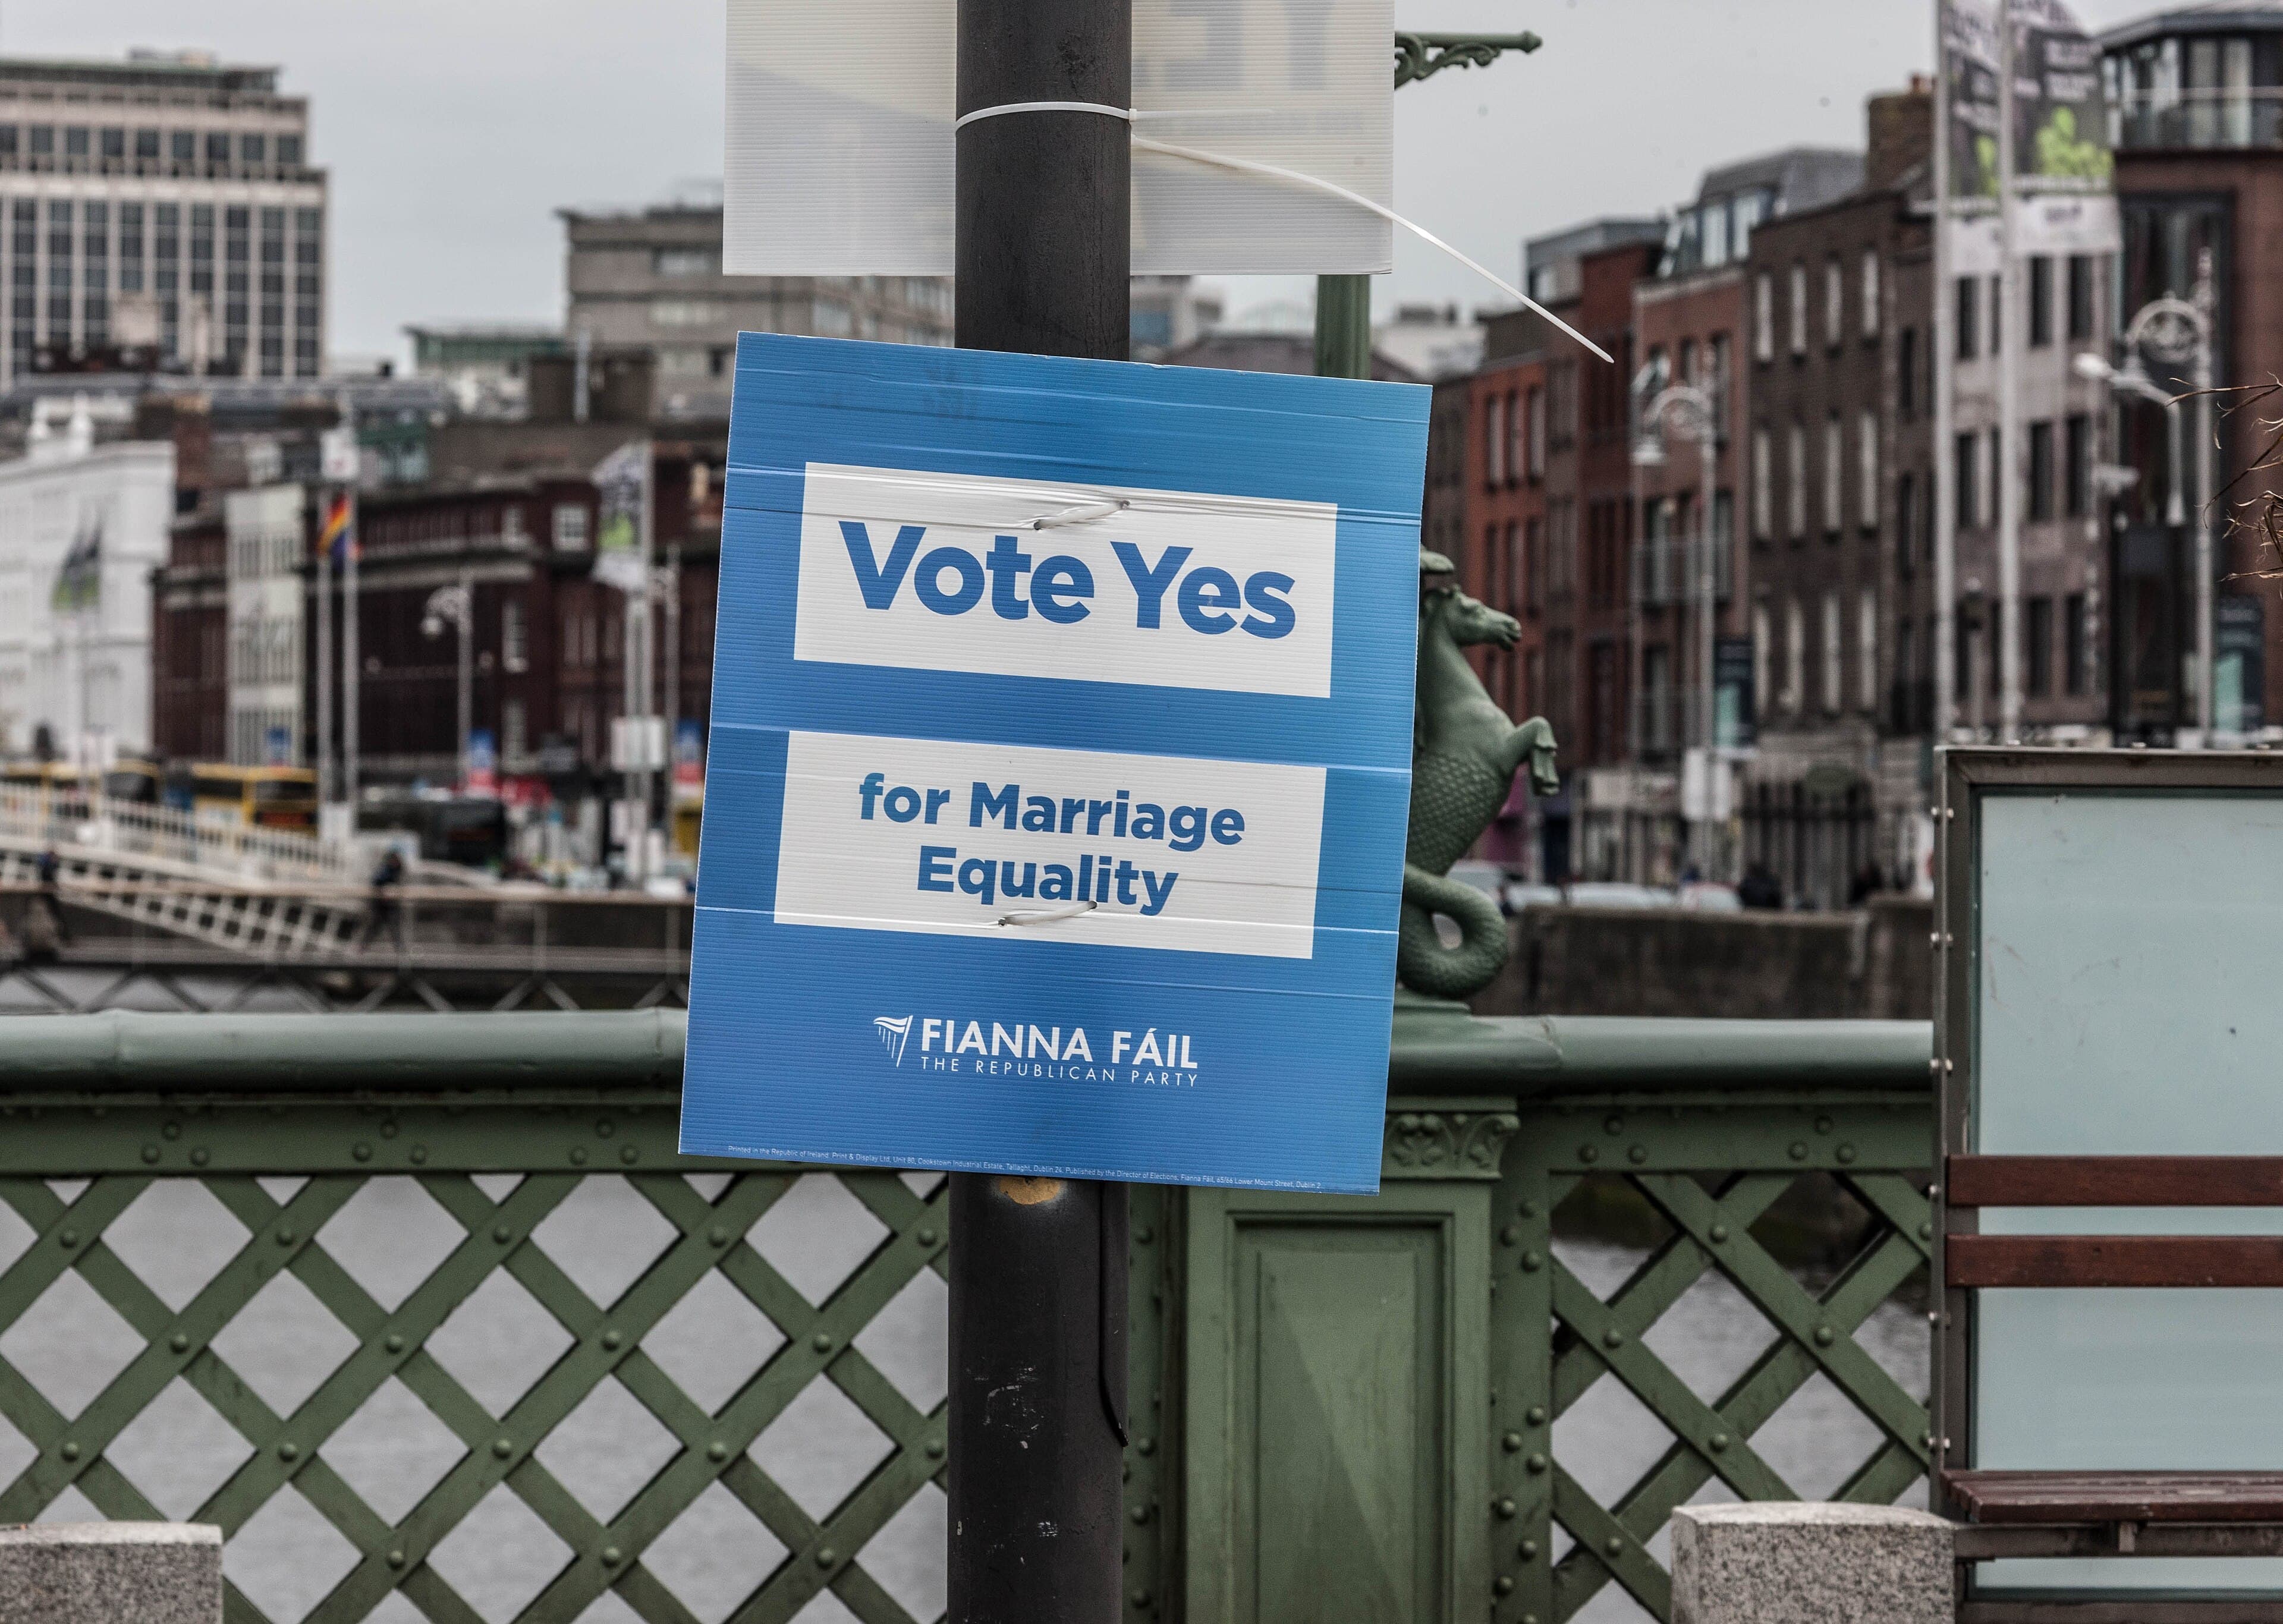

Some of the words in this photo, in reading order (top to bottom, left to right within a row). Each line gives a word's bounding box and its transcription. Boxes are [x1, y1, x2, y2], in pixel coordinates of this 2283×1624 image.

[839, 521, 1095, 624] Vote
[1111, 542, 1296, 639] Yes
[859, 772, 950, 824] for
[969, 782, 1244, 852] Marriage
[917, 845, 1178, 916] Equality
[921, 1056, 959, 1072] THE
[976, 1060, 1115, 1081] REPUBLICAN
[1131, 1070, 1198, 1087] PARTY
[922, 1018, 1093, 1062] FIANNA
[1112, 1028, 1198, 1069] FÁIL
[771, 1148, 798, 1157] Republic
[856, 1153, 878, 1162] Display
[917, 1157, 951, 1166] Cookstown
